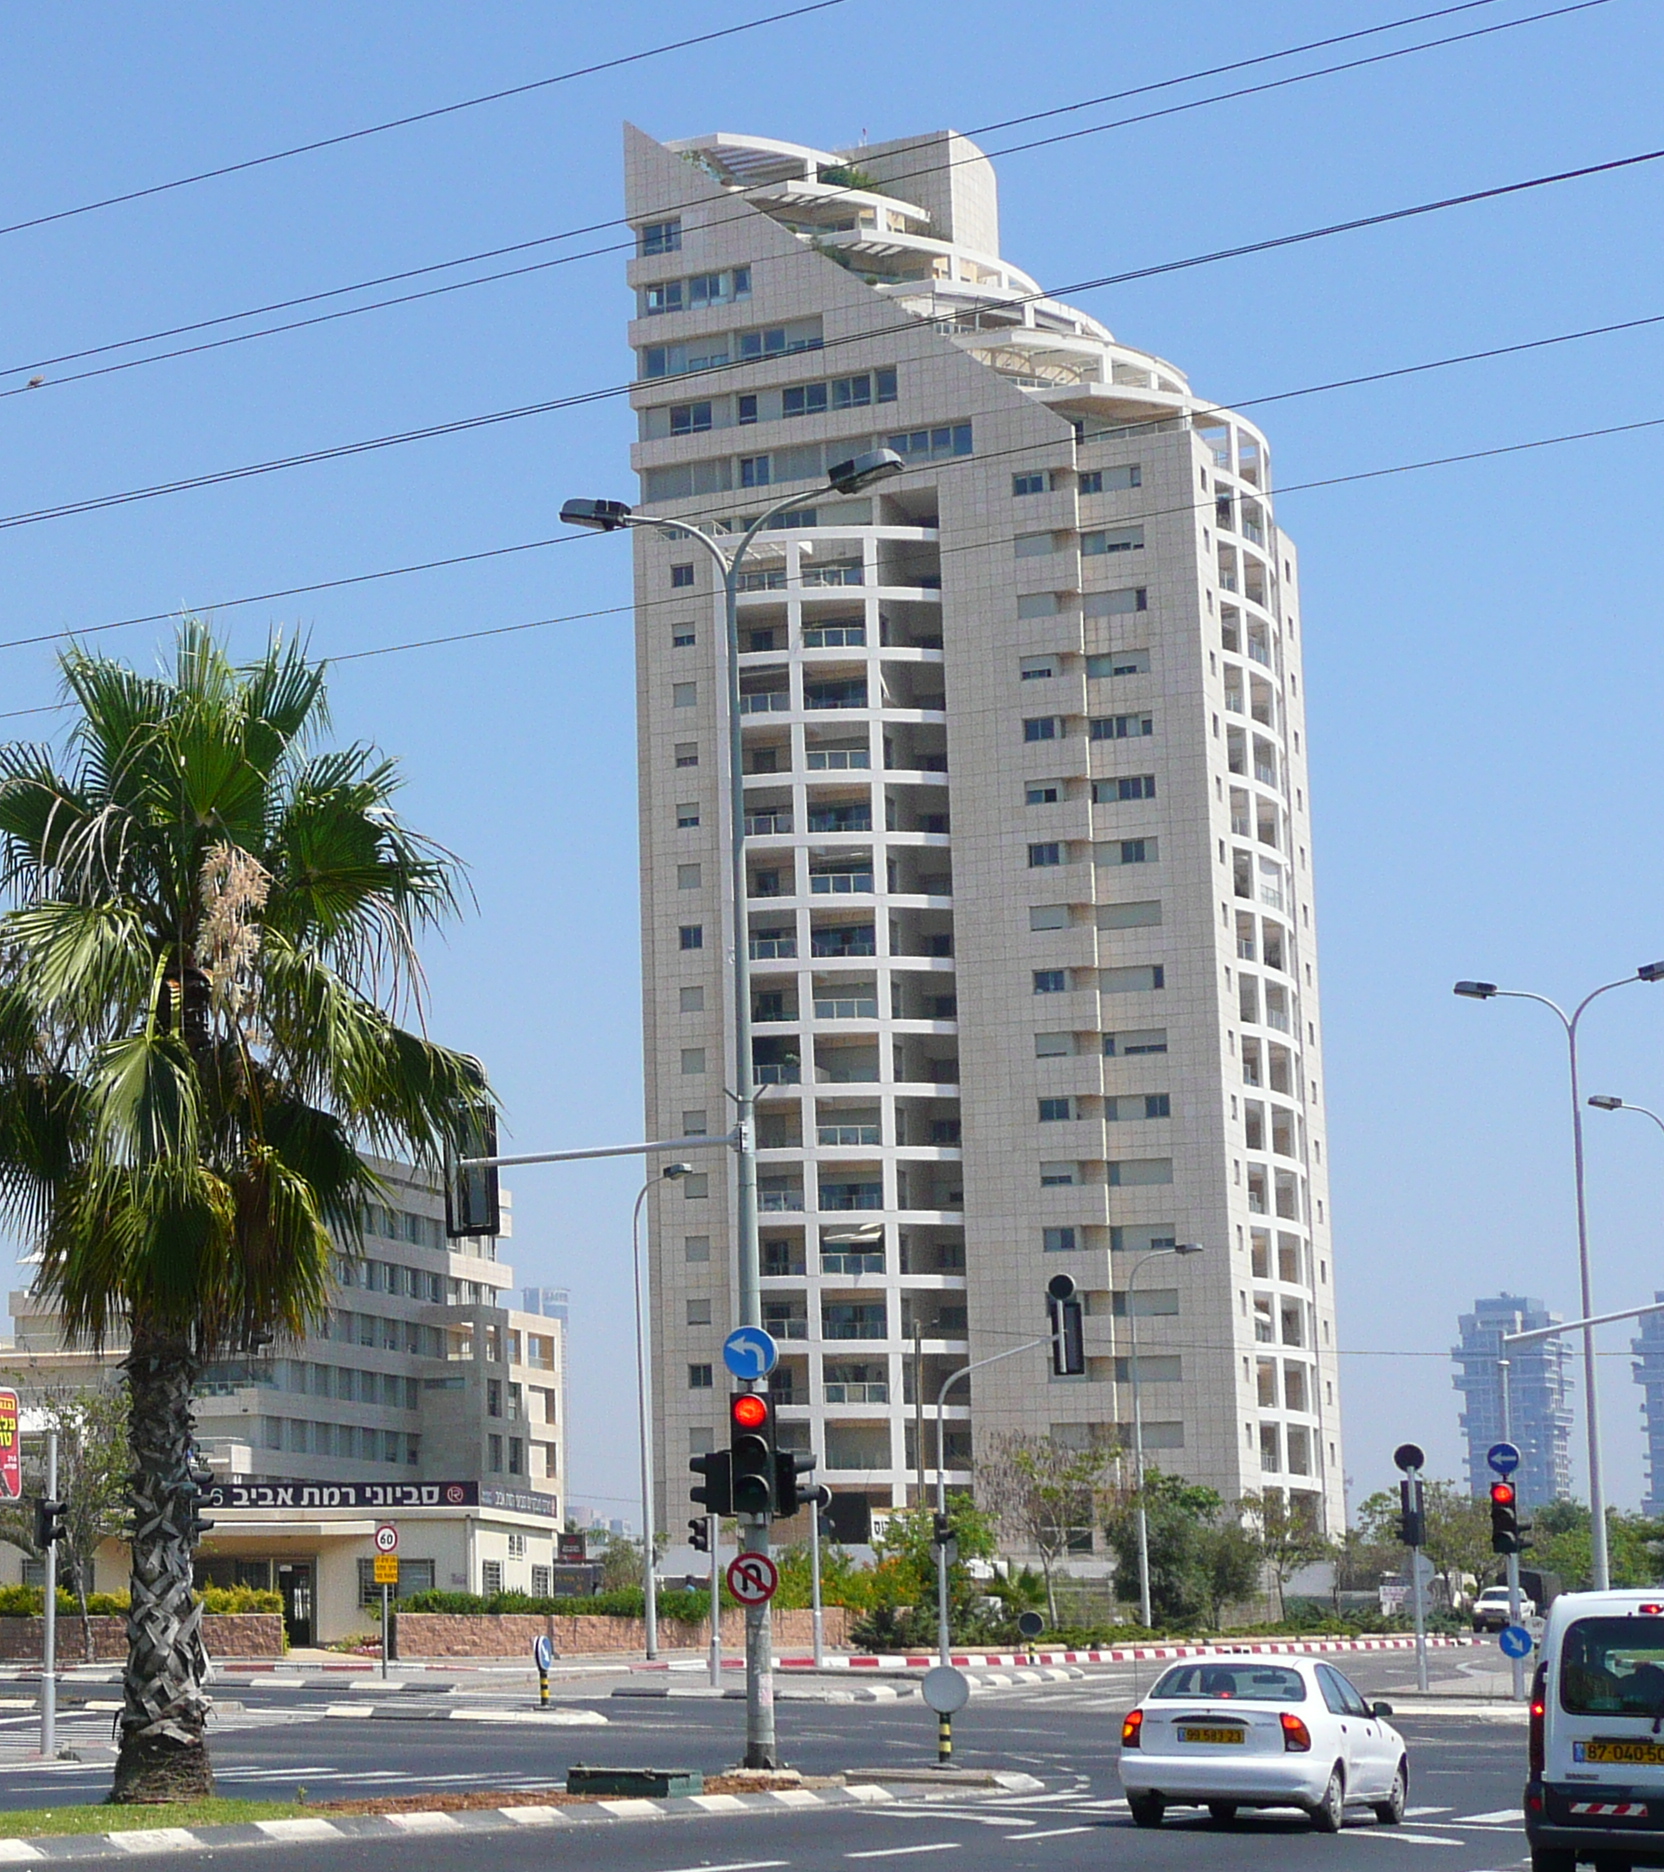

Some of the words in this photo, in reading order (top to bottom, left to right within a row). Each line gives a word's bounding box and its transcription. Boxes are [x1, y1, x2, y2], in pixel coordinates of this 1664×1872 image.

[232, 1487, 294, 1506] אביב
[301, 1487, 356, 1506] רמת
[365, 1486, 440, 1505] סביוני
[380, 1534, 393, 1545] 60
